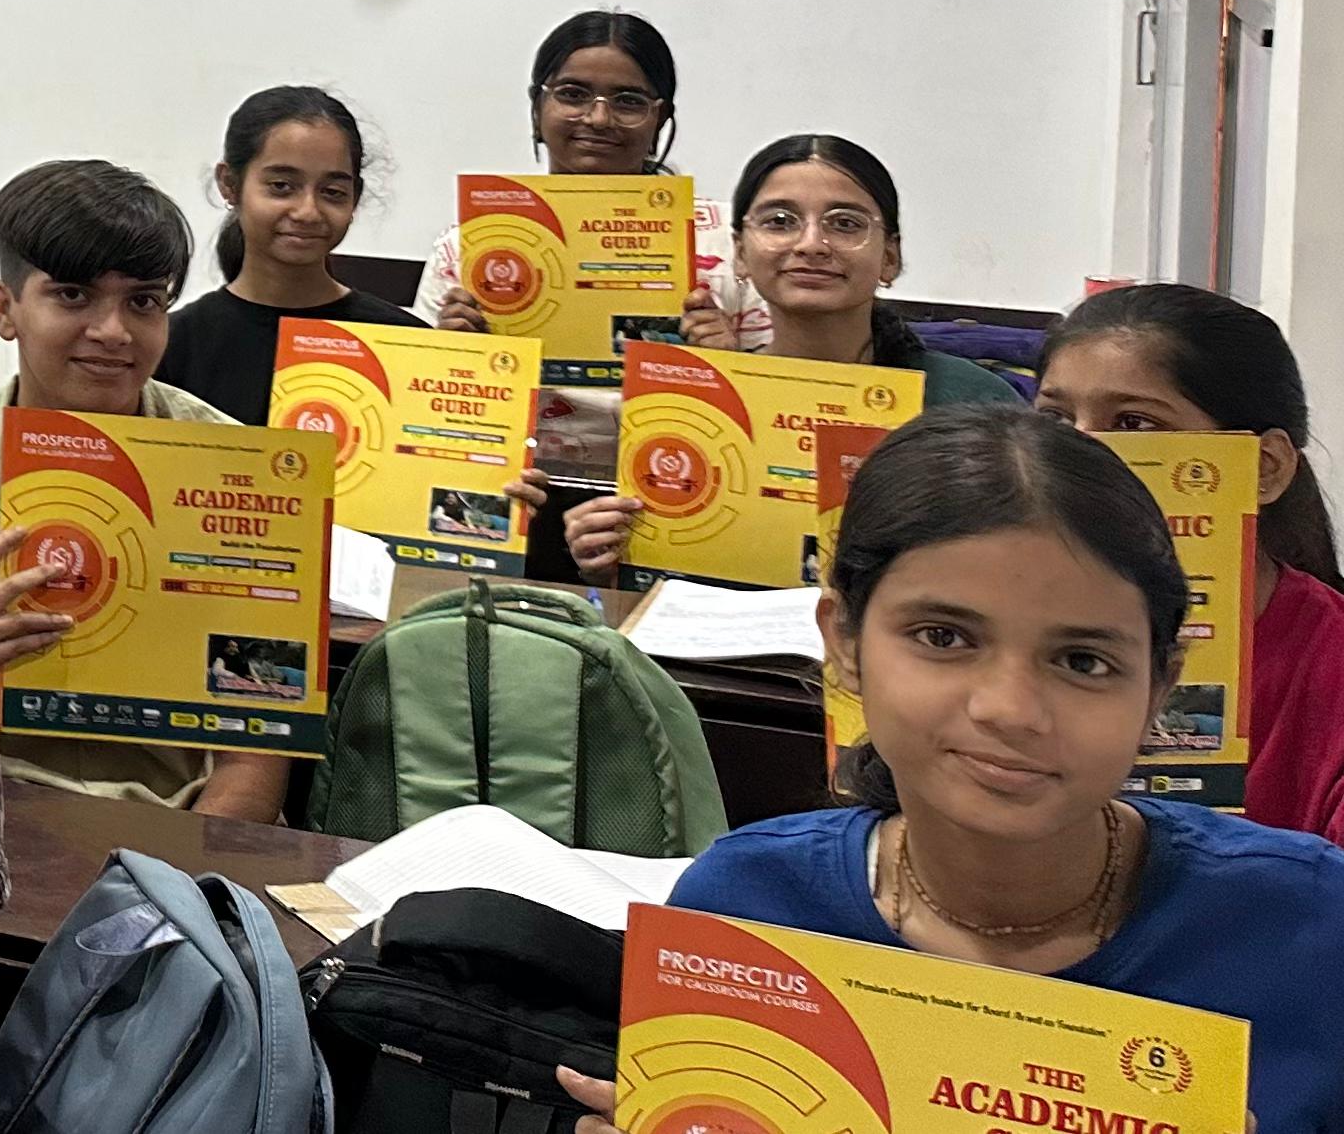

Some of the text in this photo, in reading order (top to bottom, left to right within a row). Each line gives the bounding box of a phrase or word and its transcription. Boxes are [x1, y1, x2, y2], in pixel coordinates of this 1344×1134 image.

[578, 220, 672, 233] ACADEMIC
[601, 237, 650, 249] GURU
[407, 378, 514, 401] ACADEMIC
[431, 398, 486, 416] GURU
[22, 432, 108, 451] PROSPECTUS
[221, 473, 254, 487] THE
[173, 488, 302, 516] ACADEMIC
[202, 514, 270, 537] GURU
[657, 948, 808, 995] PROSPECTUS
[657, 972, 681, 986] FOR
[763, 993, 821, 1015] COURSES
[1148, 1047, 1167, 1069] 6
[1023, 1063, 1085, 1094] THE
